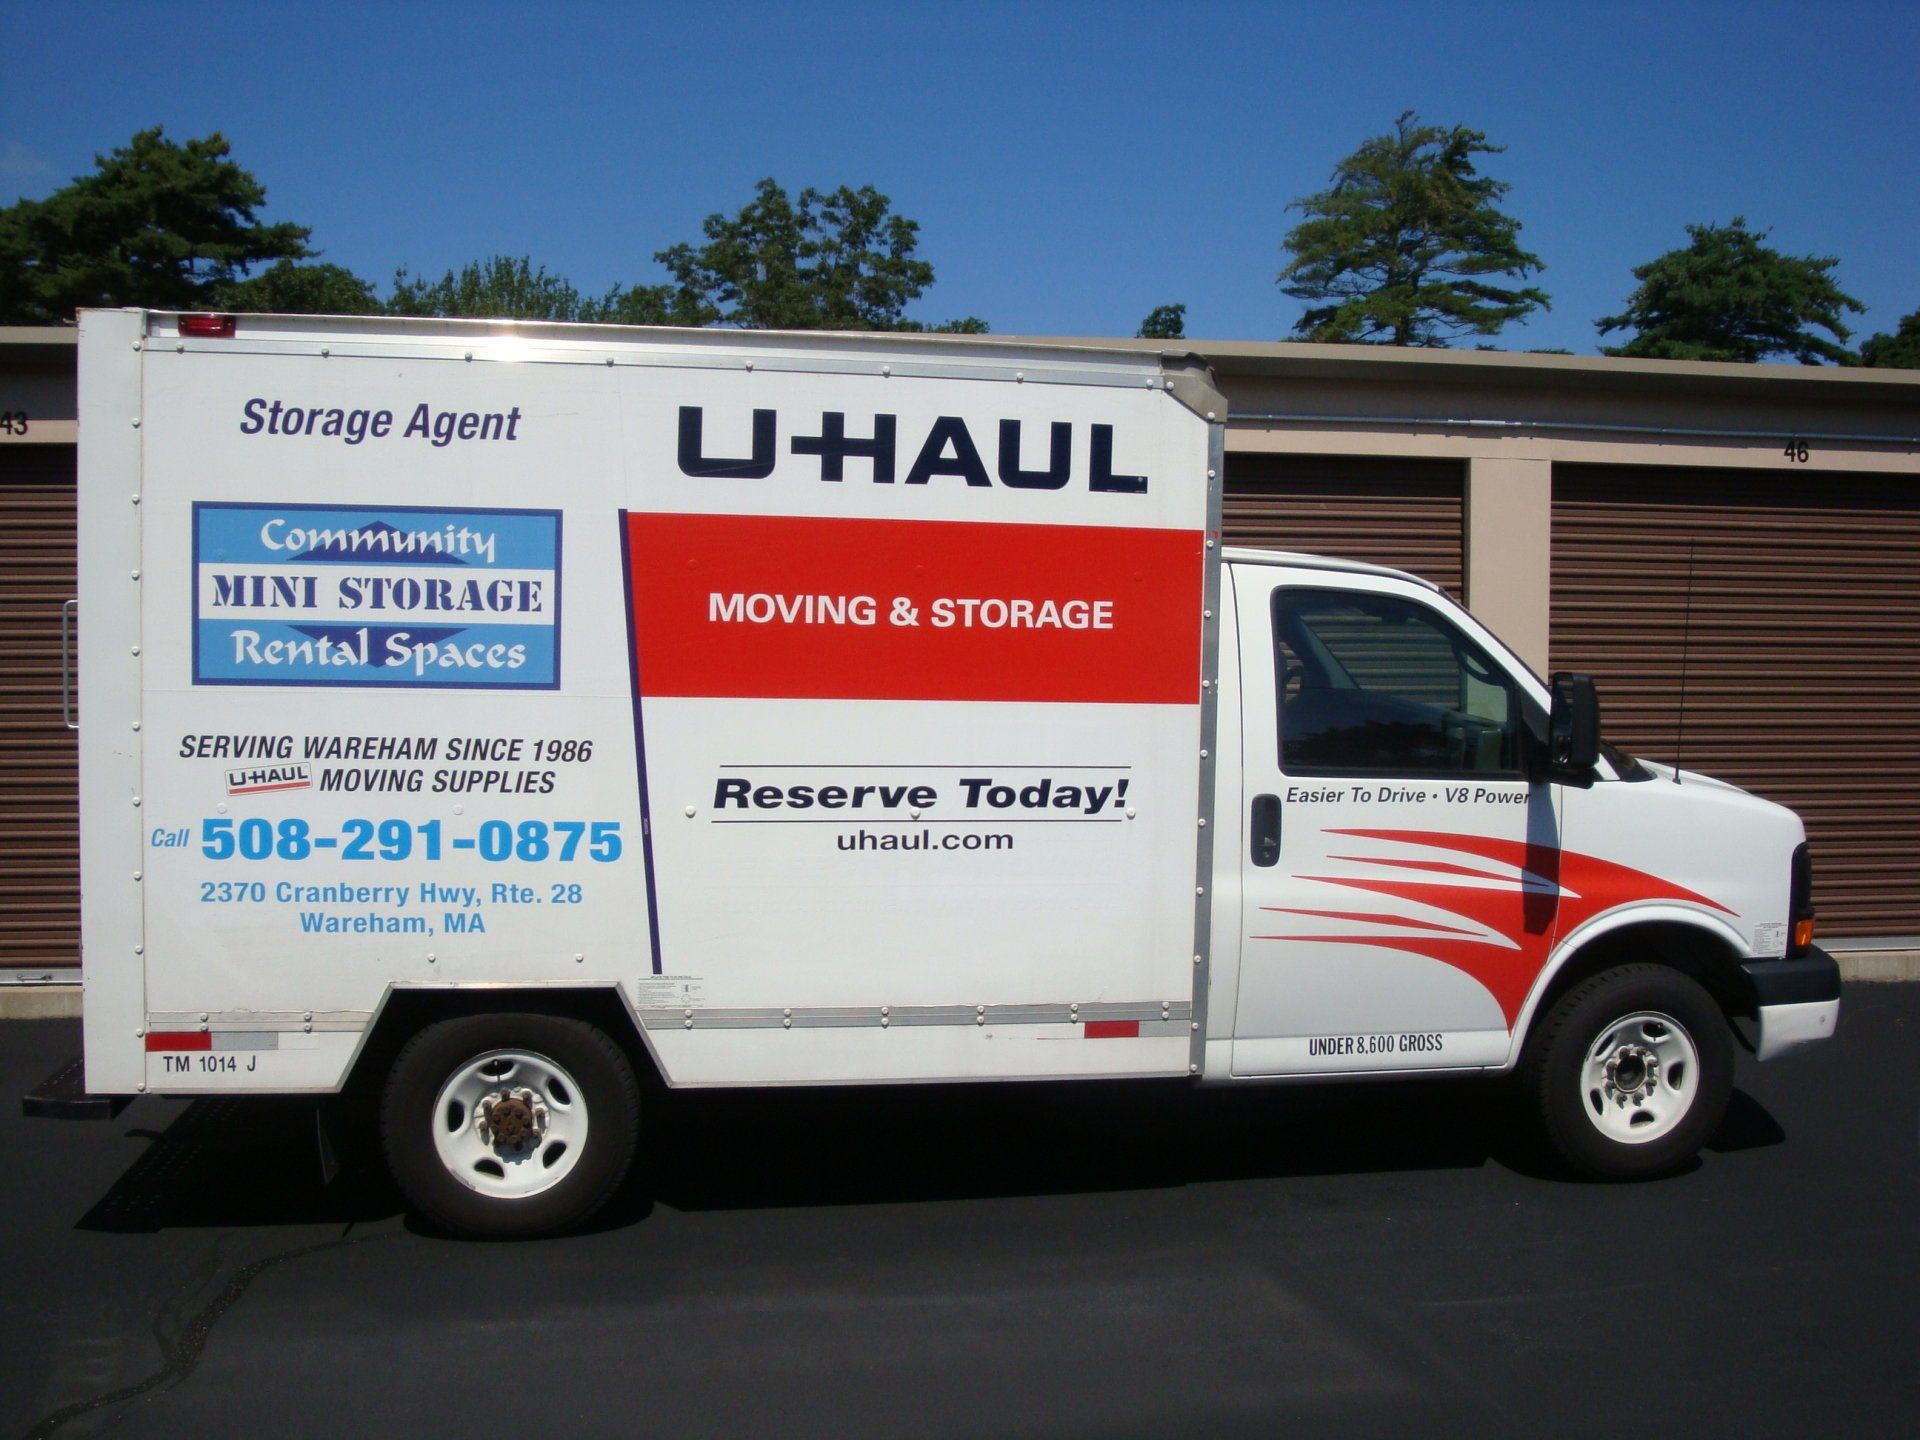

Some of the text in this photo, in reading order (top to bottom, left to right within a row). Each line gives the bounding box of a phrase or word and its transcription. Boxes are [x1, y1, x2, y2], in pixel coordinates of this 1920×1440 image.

[0, 411, 28, 435] 43
[240, 398, 521, 446] Storage Agent
[1784, 440, 1809, 463] 46
[260, 519, 497, 562] Community
[212, 574, 543, 613] MINI STORAGE
[708, 592, 1114, 629] MOVING & STORAGE
[230, 628, 526, 676] Rental Spaces
[178, 735, 593, 763] SERVING WAREHAM SINCE 1986
[319, 768, 556, 795] MOVING SUPPLIES
[1286, 786, 1531, 804] Easier To Drive V8 Power
[712, 778, 1130, 815] Reserve Today!
[151, 828, 190, 849] Call
[201, 817, 623, 863] 508-291-0875
[836, 829, 1015, 851] uhaul.com
[200, 881, 583, 908] 2370 Cranberry Hwy, Rte. 28
[299, 911, 486, 938] Wareham, MA
[1309, 1038, 1353, 1056] UNDER
[1399, 1033, 1443, 1052] GROSS
[163, 1055, 256, 1072] TM 1014 J
